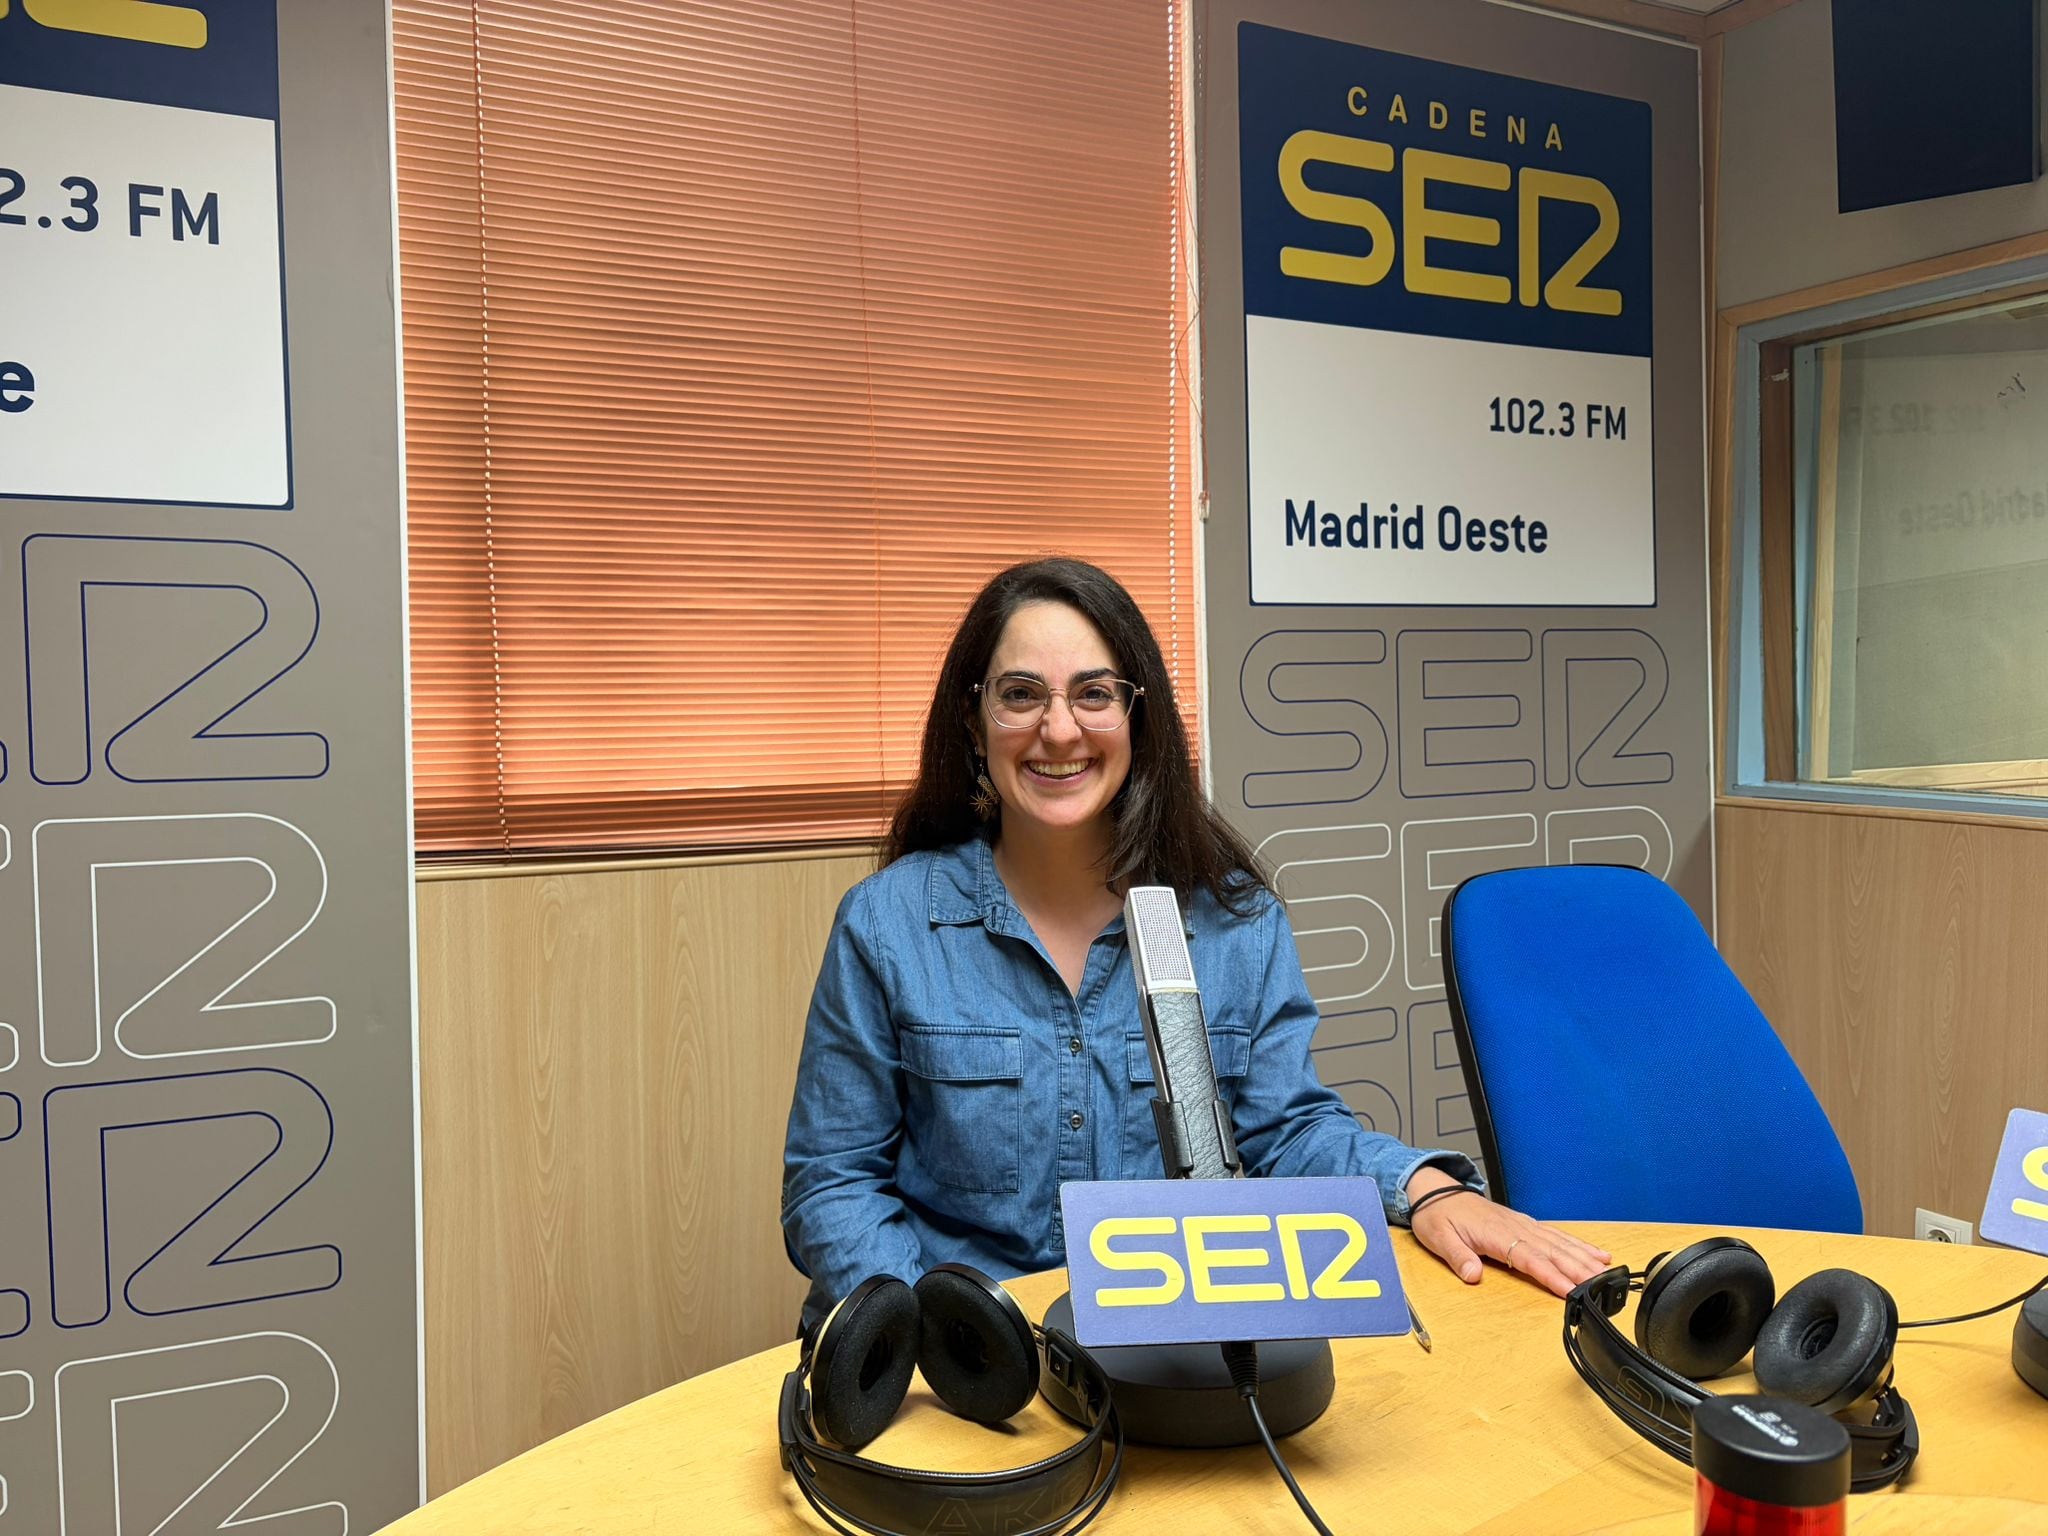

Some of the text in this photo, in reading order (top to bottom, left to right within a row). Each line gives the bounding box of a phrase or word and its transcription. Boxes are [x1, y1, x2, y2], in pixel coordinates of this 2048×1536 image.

[1347, 86, 1562, 151] CADENA
[128, 183, 219, 245] FM
[1278, 129, 1622, 316] SER
[1489, 396, 1627, 441] 102.3 FM
[1285, 499, 1548, 554] Madrid Oeste
[1240, 628, 1674, 808] SER
[1089, 1213, 1381, 1307] SER
